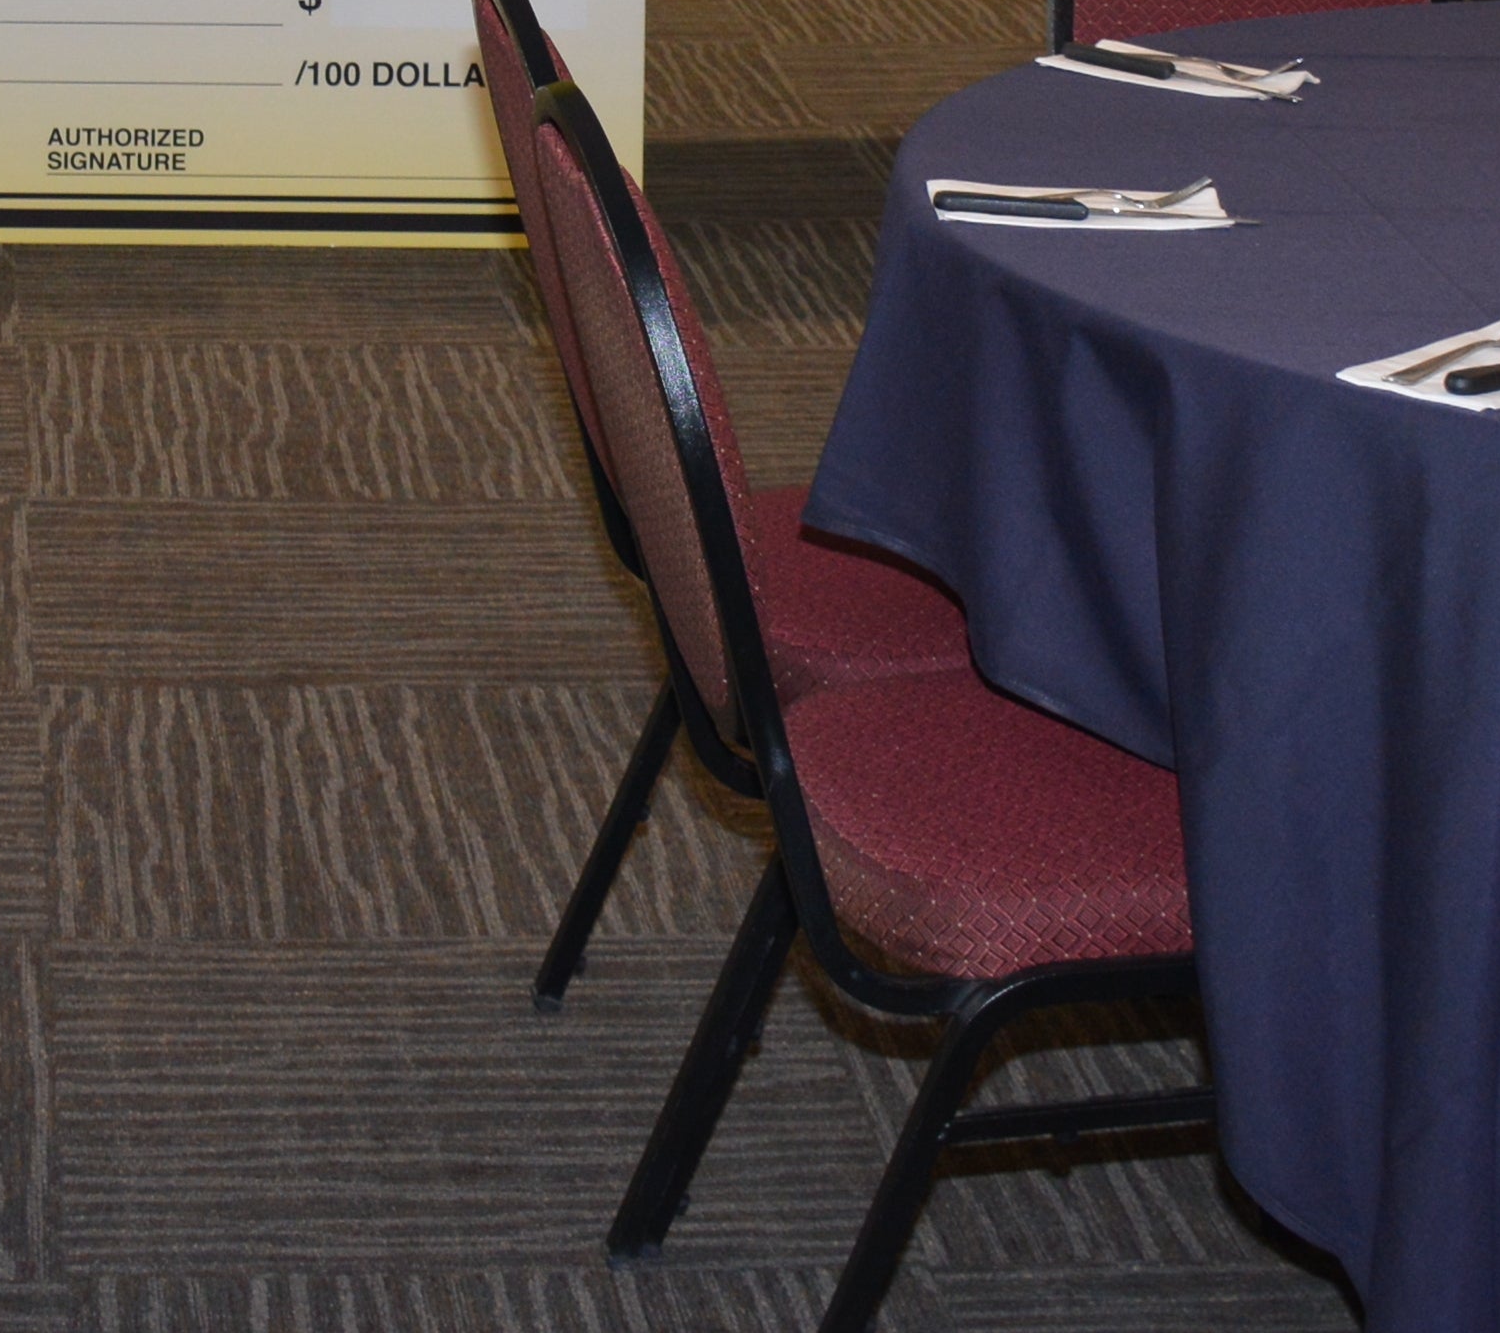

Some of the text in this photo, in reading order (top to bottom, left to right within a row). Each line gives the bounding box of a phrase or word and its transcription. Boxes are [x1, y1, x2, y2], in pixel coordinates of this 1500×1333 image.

[295, 61, 361, 86] /100
[48, 128, 204, 147] AUTHORIZED
[47, 152, 186, 171] SIGNATURE
